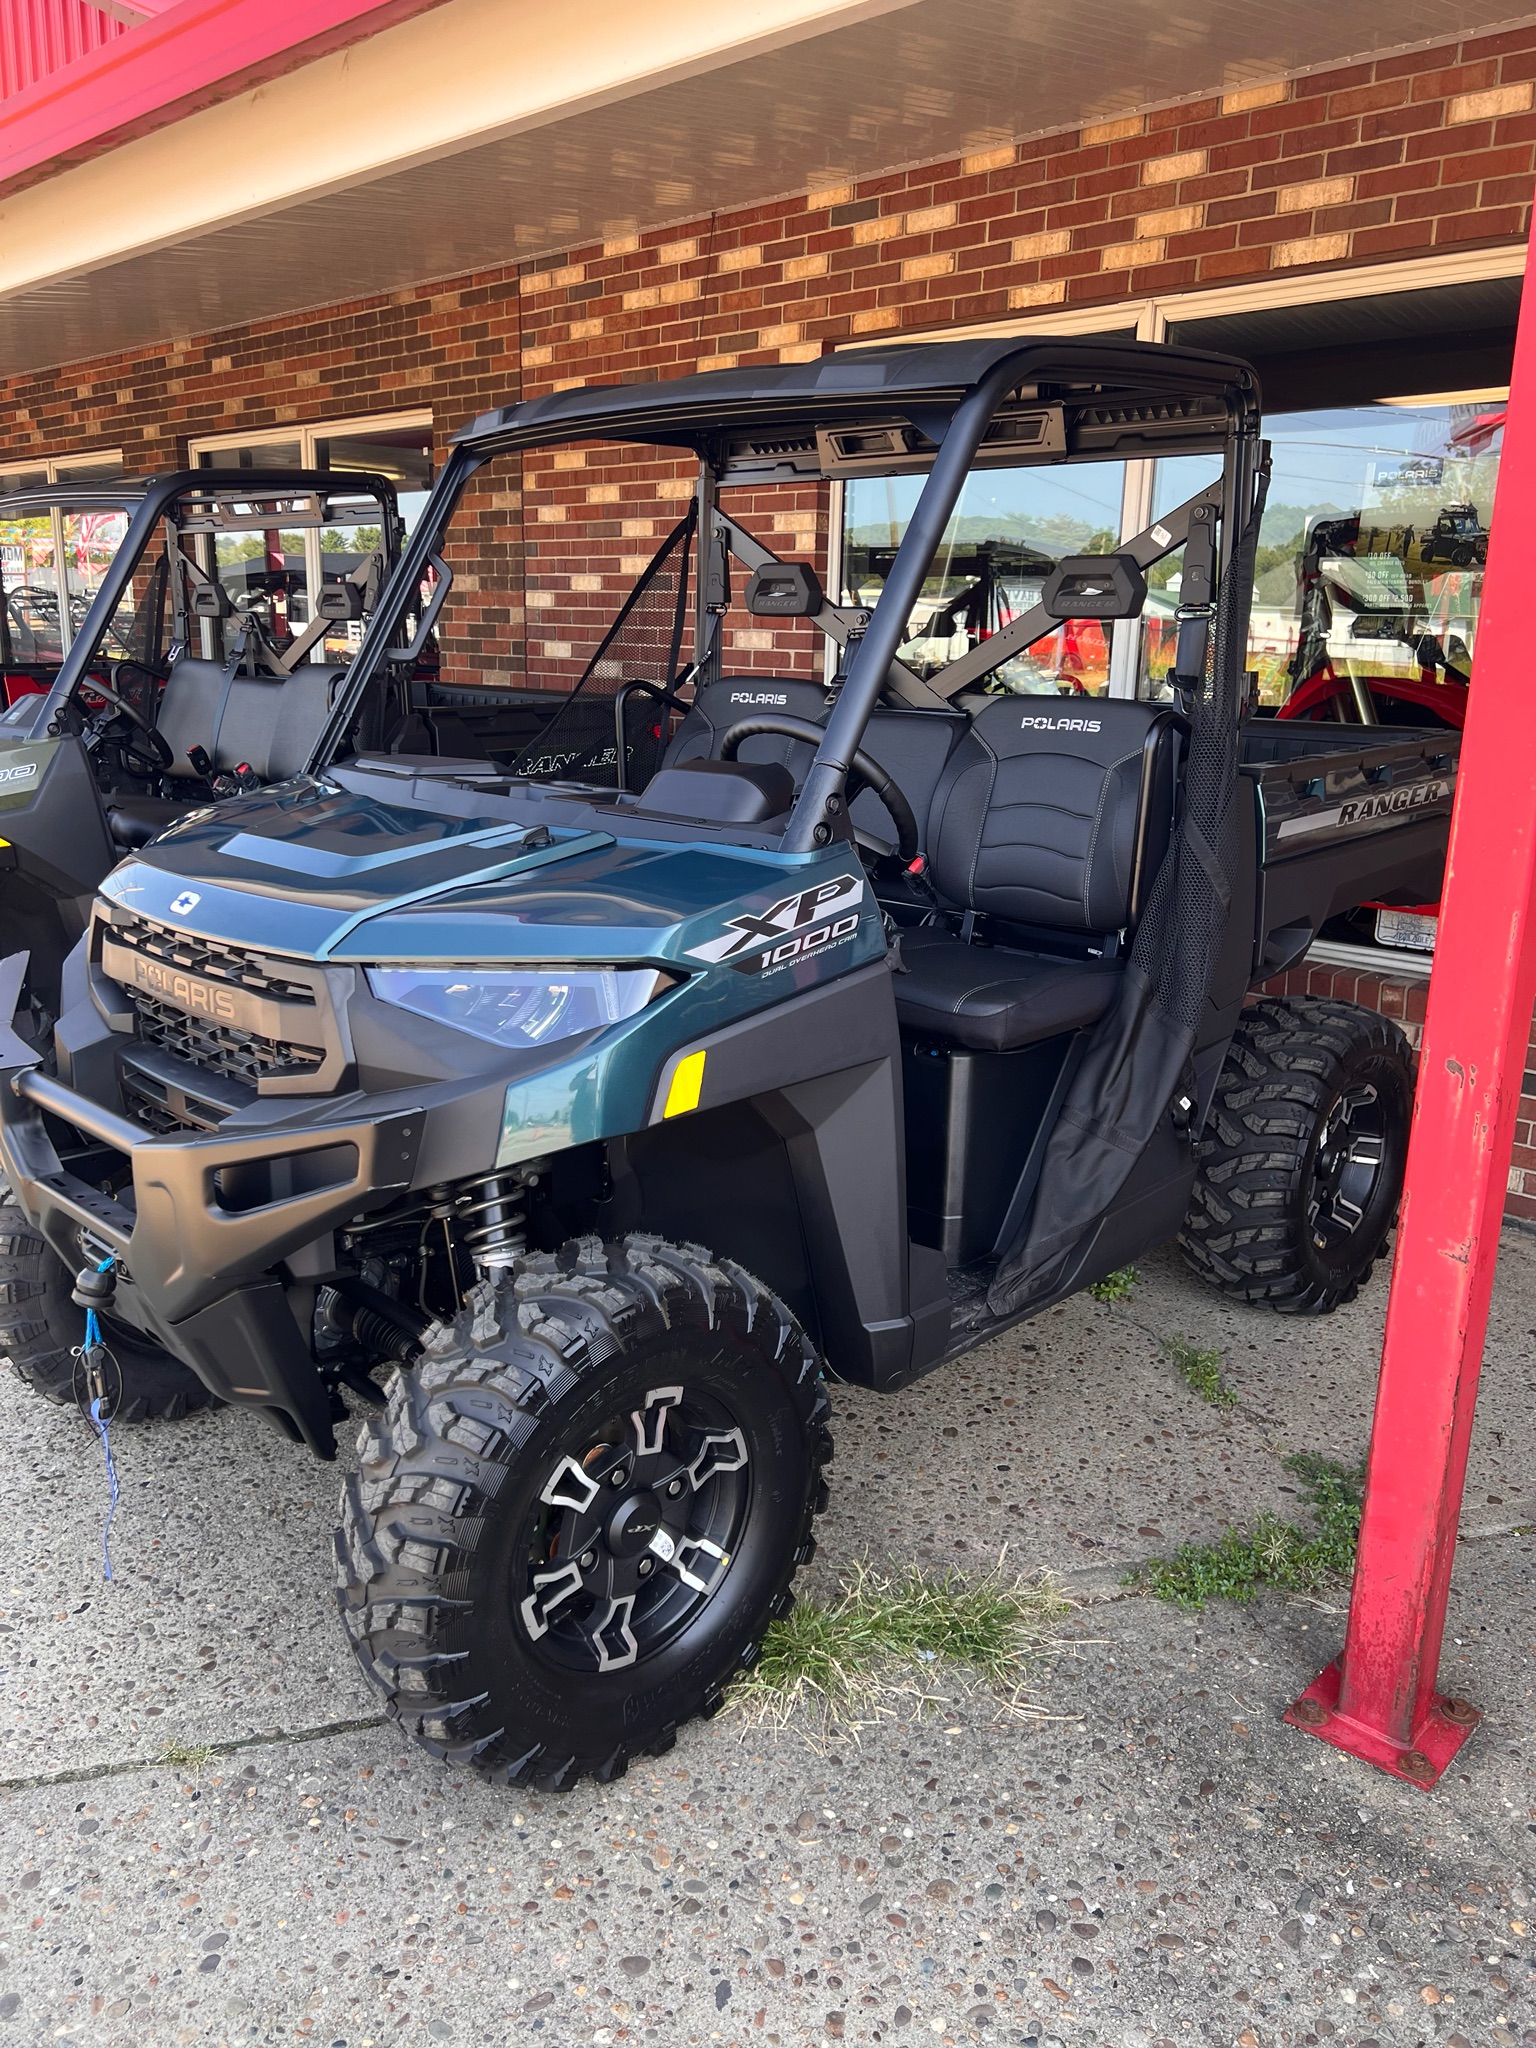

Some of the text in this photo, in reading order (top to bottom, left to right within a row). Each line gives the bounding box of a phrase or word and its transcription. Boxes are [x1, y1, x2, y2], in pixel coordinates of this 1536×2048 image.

[1378, 469, 1438, 480] POLARIS
[1380, 552, 1391, 560] OFF
[1378, 571, 1389, 579] OFF
[1060, 600, 1115, 608] RANGER
[1379, 594, 1391, 602] OFF
[731, 692, 787, 705] POLARIS
[1021, 717, 1101, 733] POLARIS
[1336, 781, 1443, 828] RANGER
[716, 874, 859, 961] XP
[761, 913, 860, 968] 1000
[761, 932, 858, 979] DUAL OVERHEAD CAM
[134, 957, 236, 1019] POLARIS
